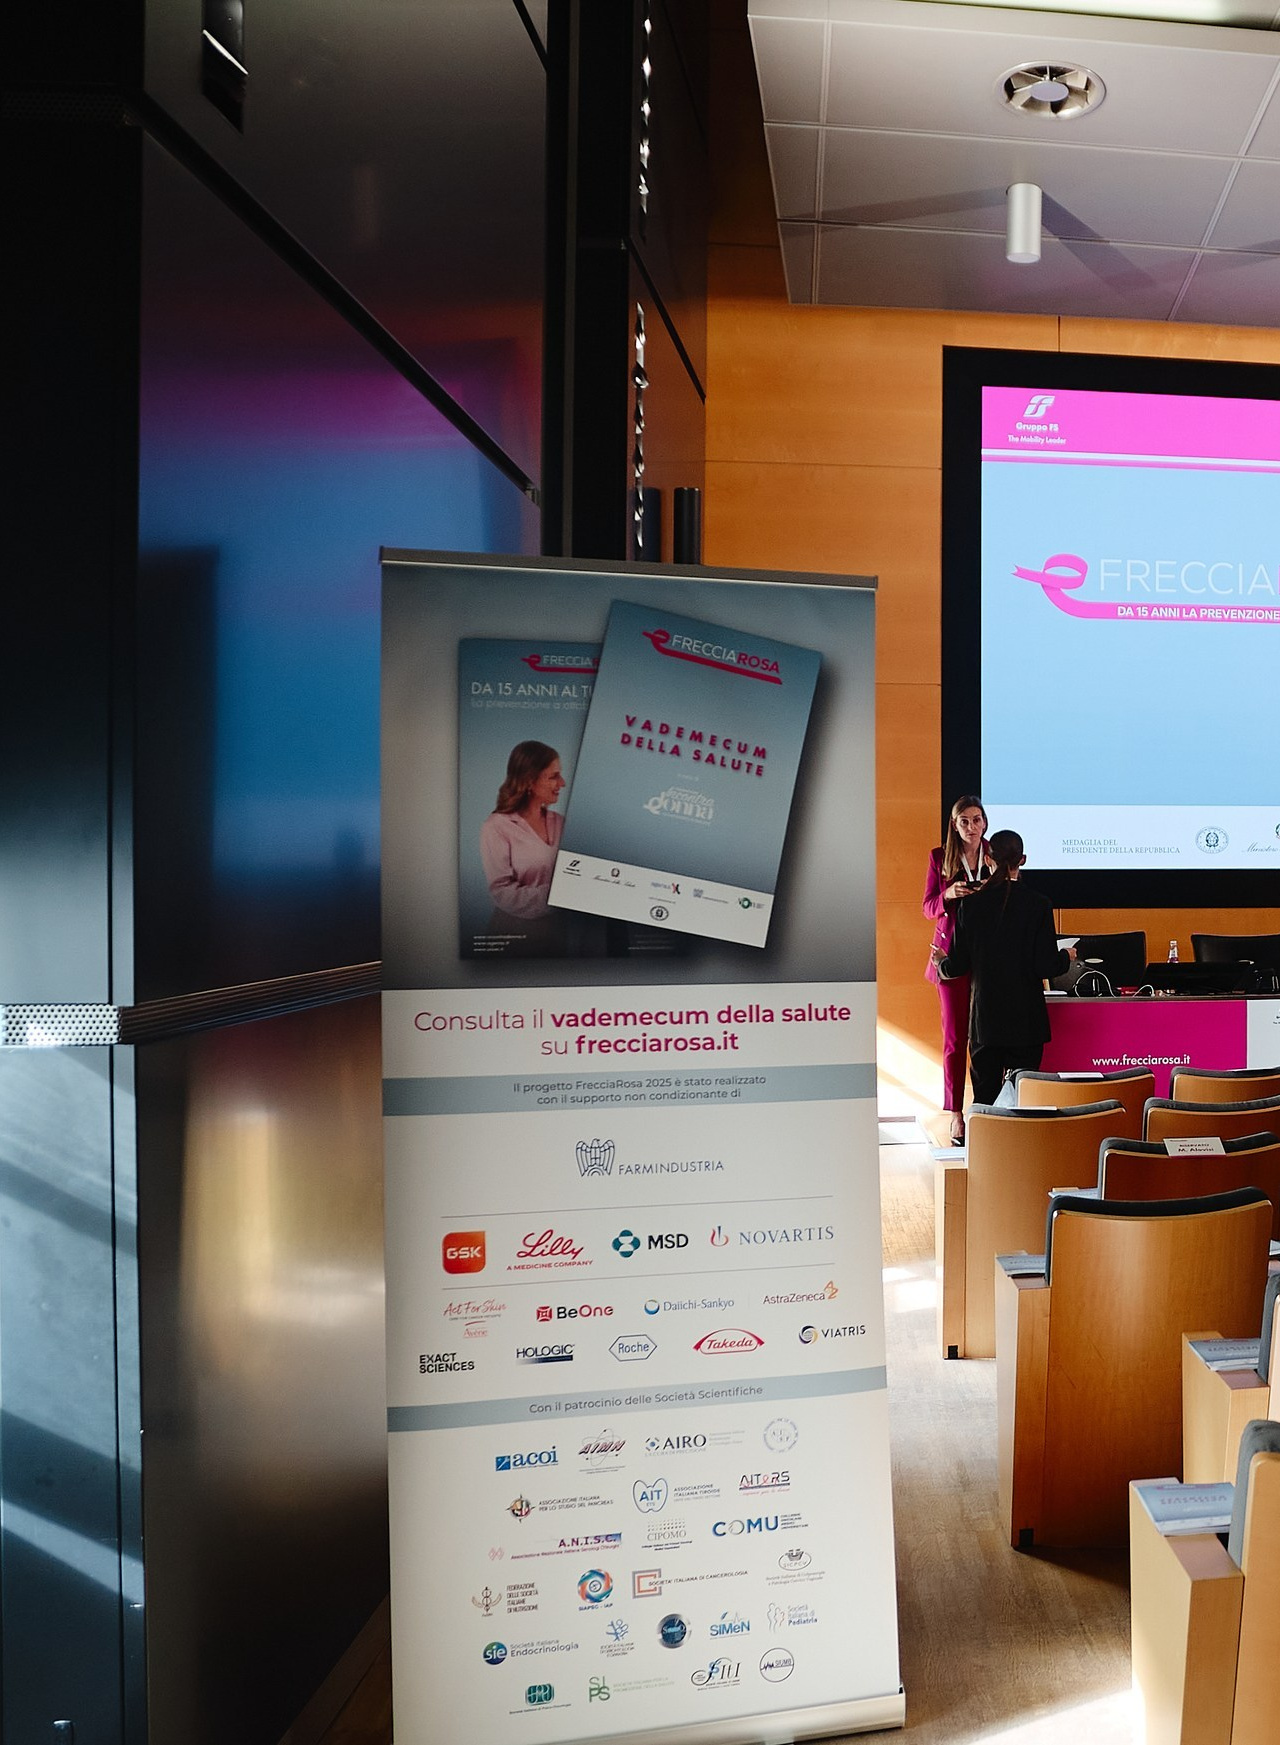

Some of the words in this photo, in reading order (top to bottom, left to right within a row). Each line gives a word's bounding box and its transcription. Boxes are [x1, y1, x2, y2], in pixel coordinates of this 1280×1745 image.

[1015, 421, 1048, 432] Gruppo
[1117, 605, 1134, 617] DA
[1135, 606, 1149, 617] 15
[1151, 606, 1181, 619] ANNI
[1182, 607, 1198, 619] LA
[1199, 608, 1280, 622] PREVENZIONE
[670, 634, 781, 674] FRECCIAROSA
[471, 682, 493, 695] DA
[498, 682, 512, 696] 15
[515, 683, 557, 697] ANNI
[561, 685, 578, 698] AL
[624, 714, 768, 760] VADEMECUM
[620, 733, 682, 757] DELLA
[692, 750, 765, 777] SALUTE
[413, 1009, 525, 1031] Consulta
[532, 1008, 544, 1029] il
[550, 1004, 710, 1028] vademecum
[716, 1004, 775, 1024] della
[781, 1002, 852, 1022] salute
[540, 1040, 568, 1056] su
[574, 1030, 740, 1055] frecciarosa.it
[1092, 1054, 1191, 1066] www.frecciarosa.it
[513, 1082, 520, 1093] Il
[523, 1079, 573, 1095] progetto
[575, 1078, 643, 1091] FrecciaRosa
[645, 1077, 672, 1088] 2025
[674, 1076, 682, 1087] è
[684, 1075, 712, 1087] stato
[714, 1074, 767, 1086] realizzato
[536, 1095, 558, 1105] con
[561, 1093, 567, 1104] il
[569, 1092, 622, 1106] supporto
[624, 1092, 646, 1102] non
[649, 1088, 728, 1101] condizionante
[730, 1088, 741, 1098] di
[617, 1160, 725, 1176] FARMINDUSTRIA
[647, 1233, 689, 1250] MSD
[739, 1225, 835, 1246] NOVARTIS
[445, 1245, 483, 1260] GSK
[516, 1229, 585, 1260] Lilly
[513, 1262, 553, 1271] MEDICINE
[554, 1259, 594, 1269] COMPANY
[662, 1298, 735, 1312] Daiichi-Sankyo
[763, 1291, 826, 1305] AstraZeneca
[556, 1304, 614, 1320] BeOne
[821, 1324, 867, 1339] VIATRIS
[516, 1343, 573, 1359] HOLOGIC
[617, 1342, 650, 1354] Roche
[705, 1336, 754, 1350] Takeda
[419, 1352, 457, 1364] EXACT
[419, 1360, 475, 1374] SCIENCES
[529, 1403, 552, 1414] Con
[555, 1401, 562, 1411] il
[564, 1398, 622, 1412] patrocinio
[624, 1394, 652, 1406] delle
[654, 1391, 695, 1403] Società
[698, 1385, 764, 1400] Scientifiche
[662, 1433, 707, 1451] AIRO
[512, 1445, 559, 1467] acoi
[639, 1489, 663, 1502] AIT
[712, 1515, 779, 1537] COMU
[558, 1533, 617, 1548] A.N.I.S.C.
[646, 1529, 687, 1542] CIPOMO
[710, 1620, 751, 1637] SIMeN
[483, 1644, 507, 1662] sie
[510, 1642, 580, 1658] Endocrinologia
